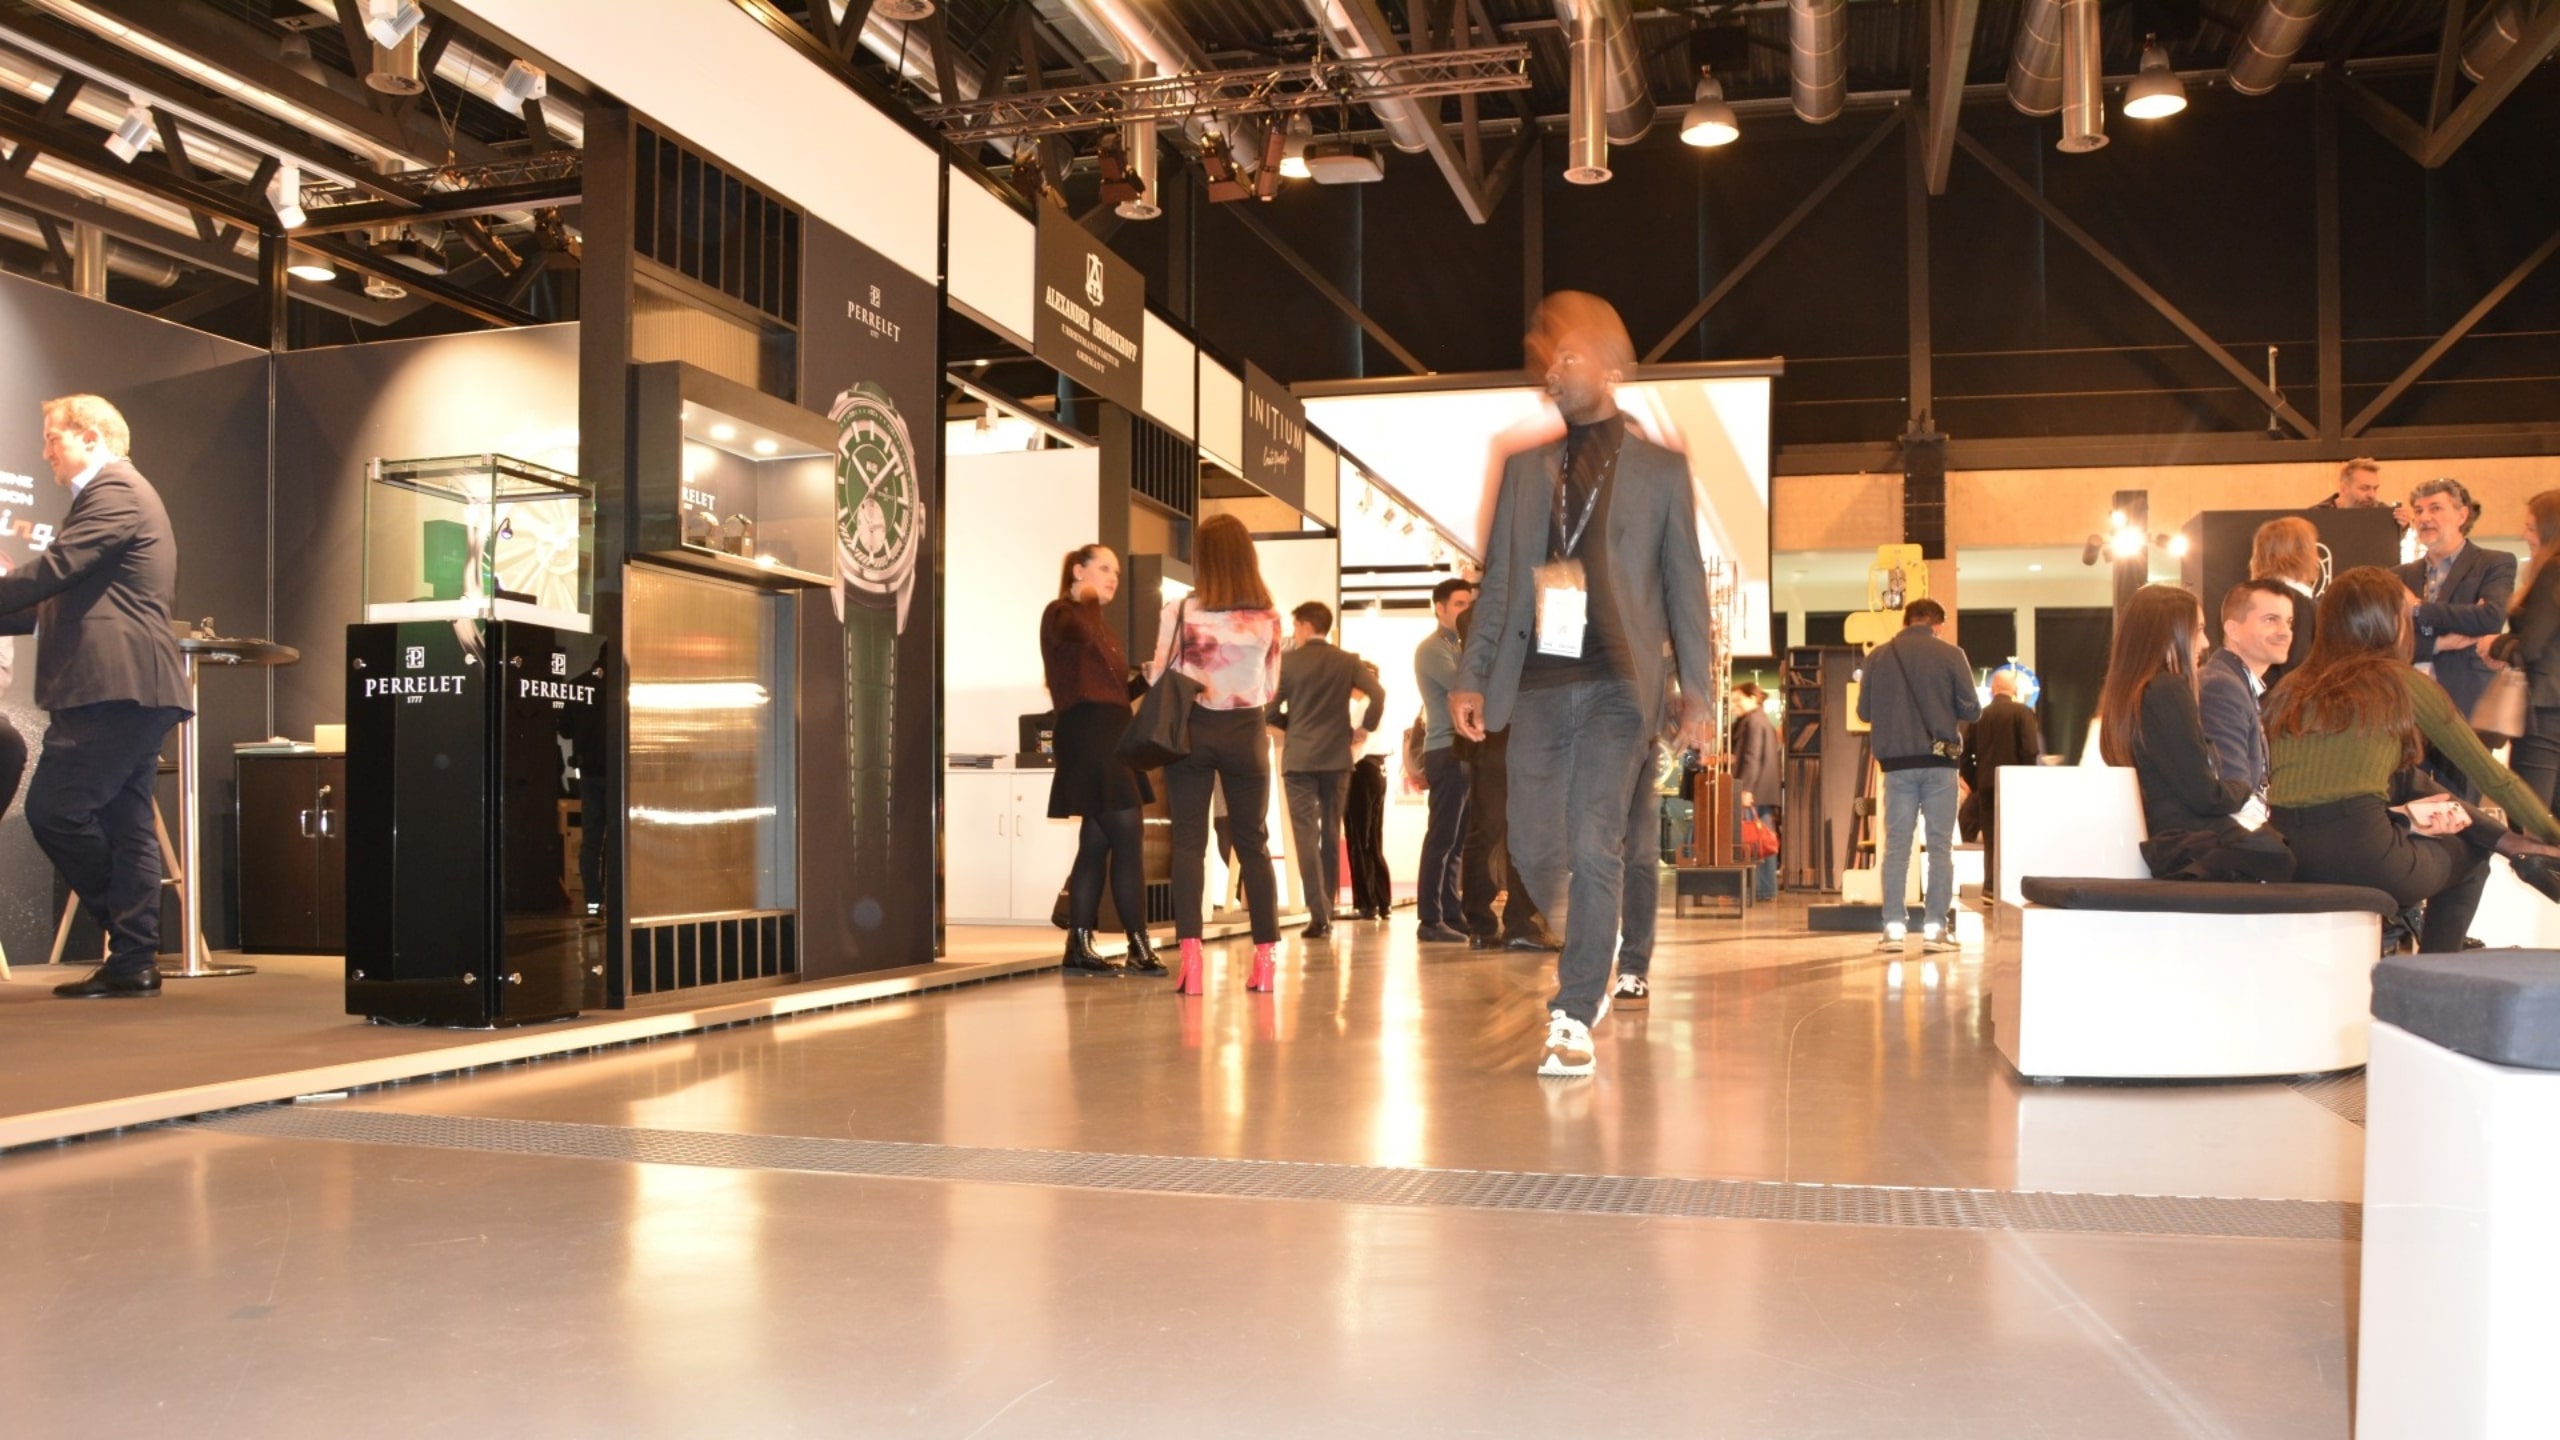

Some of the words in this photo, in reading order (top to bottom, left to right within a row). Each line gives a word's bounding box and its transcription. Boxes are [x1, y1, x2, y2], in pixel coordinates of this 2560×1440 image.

[848, 301, 900, 342] PERRELET
[1045, 285, 1090, 332] ALEXANDER
[1250, 390, 1302, 453] INITIUM
[365, 675, 466, 698] PERRELET
[520, 678, 596, 705] PERRELET
